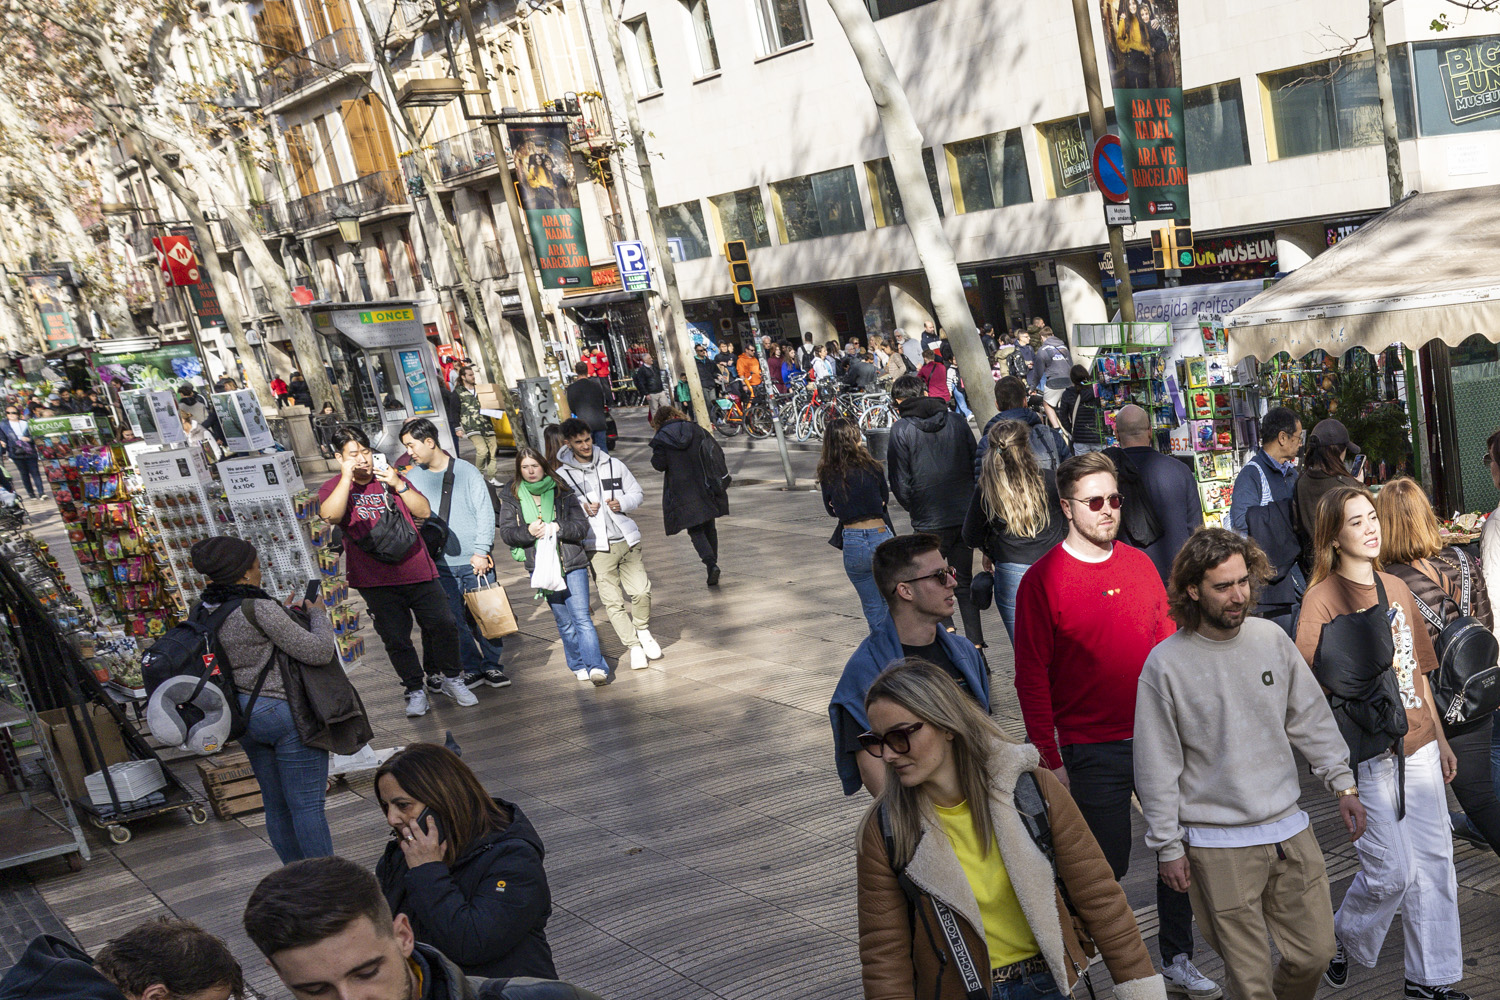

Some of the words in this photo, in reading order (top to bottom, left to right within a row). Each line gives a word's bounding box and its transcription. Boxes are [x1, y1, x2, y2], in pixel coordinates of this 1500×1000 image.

[1131, 98, 1154, 118] ARA
[1155, 98, 1172, 118] VE
[1134, 120, 1173, 140] NADAL
[1061, 140, 1089, 169] FUN
[1138, 146, 1159, 166] ARA
[1159, 146, 1177, 165] VE
[541, 215, 561, 227] ARA
[560, 214, 573, 226] VE
[545, 227, 574, 240] NADAL
[176, 249, 188, 260] M
[548, 244, 566, 255] ARA
[566, 243, 579, 255] VE
[619, 244, 641, 271] P
[1217, 239, 1278, 264] MUSEUM
[540, 256, 590, 270] BARCELONA
[1003, 275, 1023, 291] ATM
[376, 310, 411, 321] ONCE
[1136, 298, 1188, 322] Recogida
[1191, 297, 1234, 315] aceites
[942, 912, 960, 940] KORS
[953, 943, 977, 981] MICHAEL
